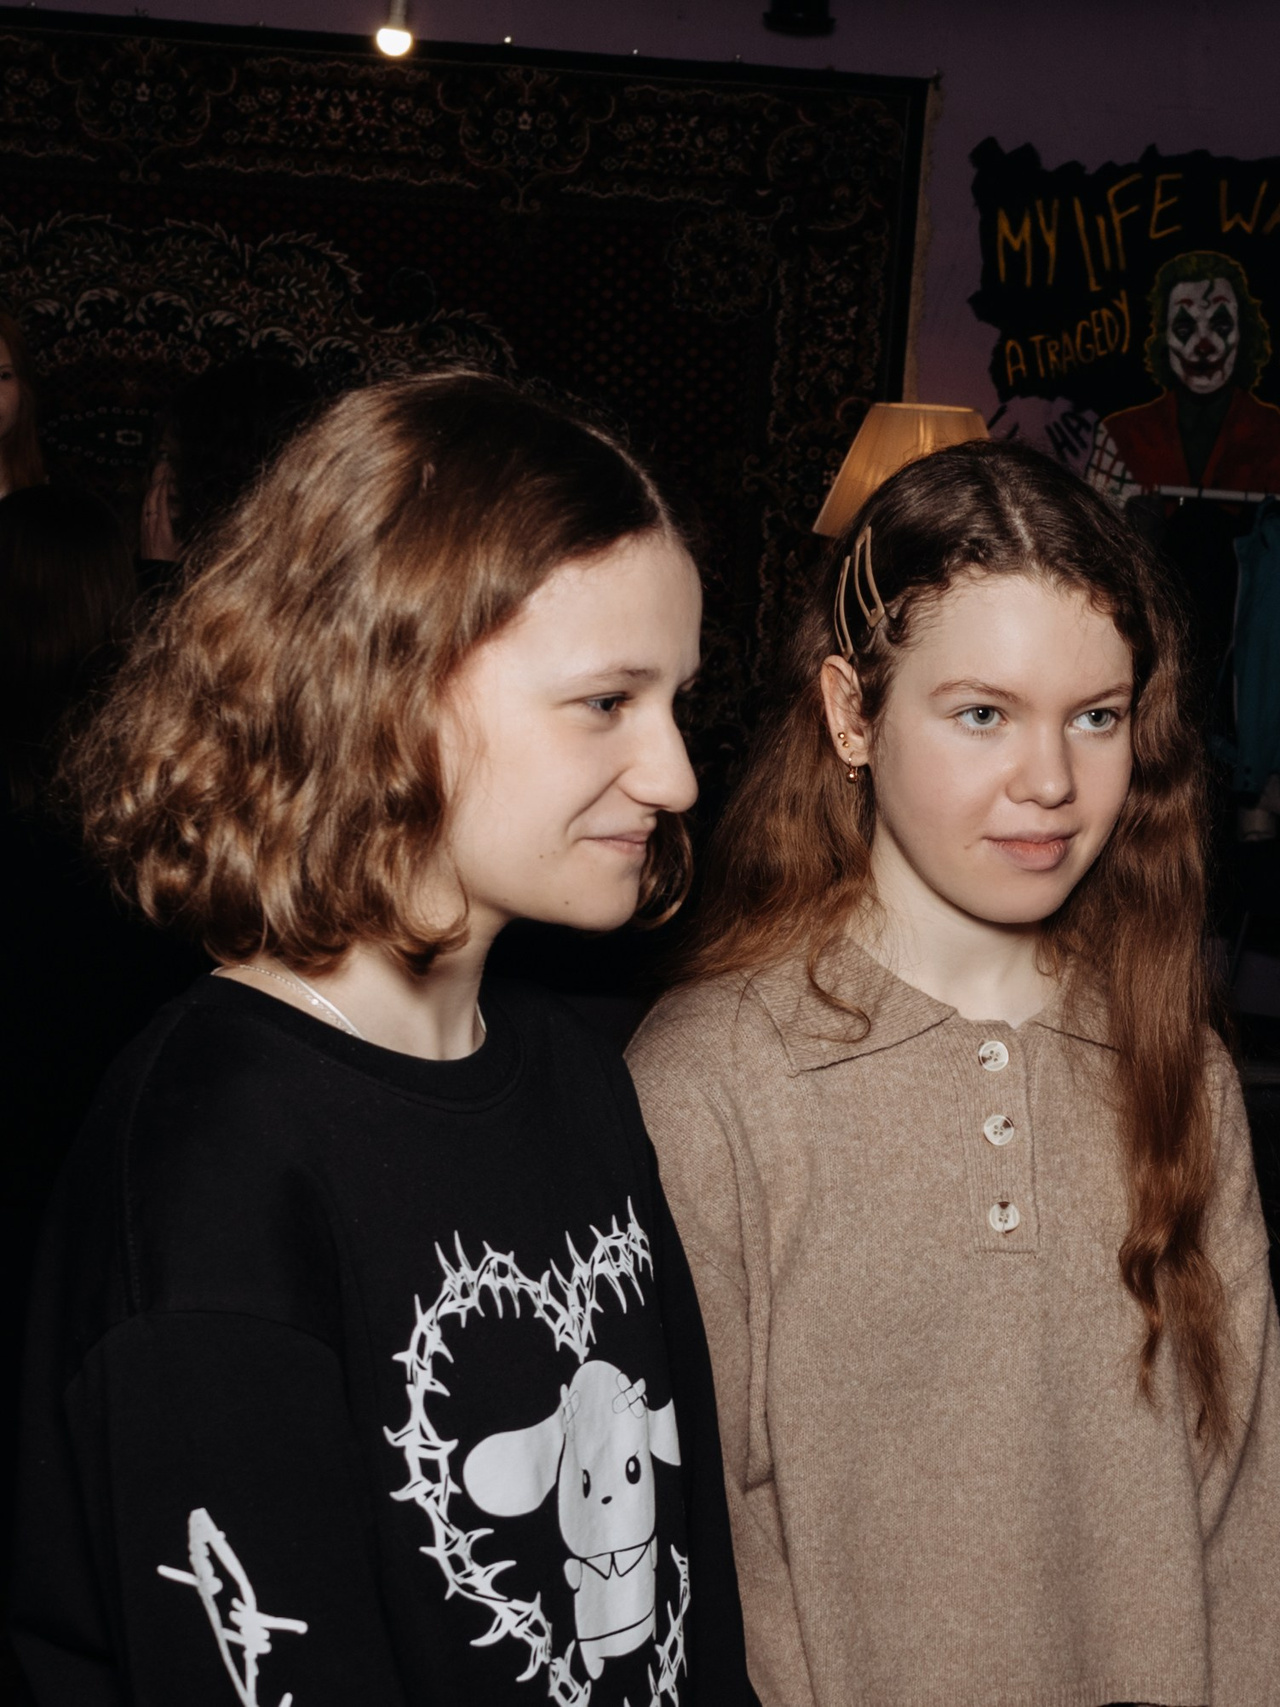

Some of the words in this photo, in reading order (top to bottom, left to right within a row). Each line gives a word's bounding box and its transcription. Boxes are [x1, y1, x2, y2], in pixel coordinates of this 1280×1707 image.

[996, 197, 1061, 288] MY
[1073, 172, 1184, 292] LIFE
[1005, 338, 1028, 387] A
[1028, 289, 1132, 379] TRAGEDY
